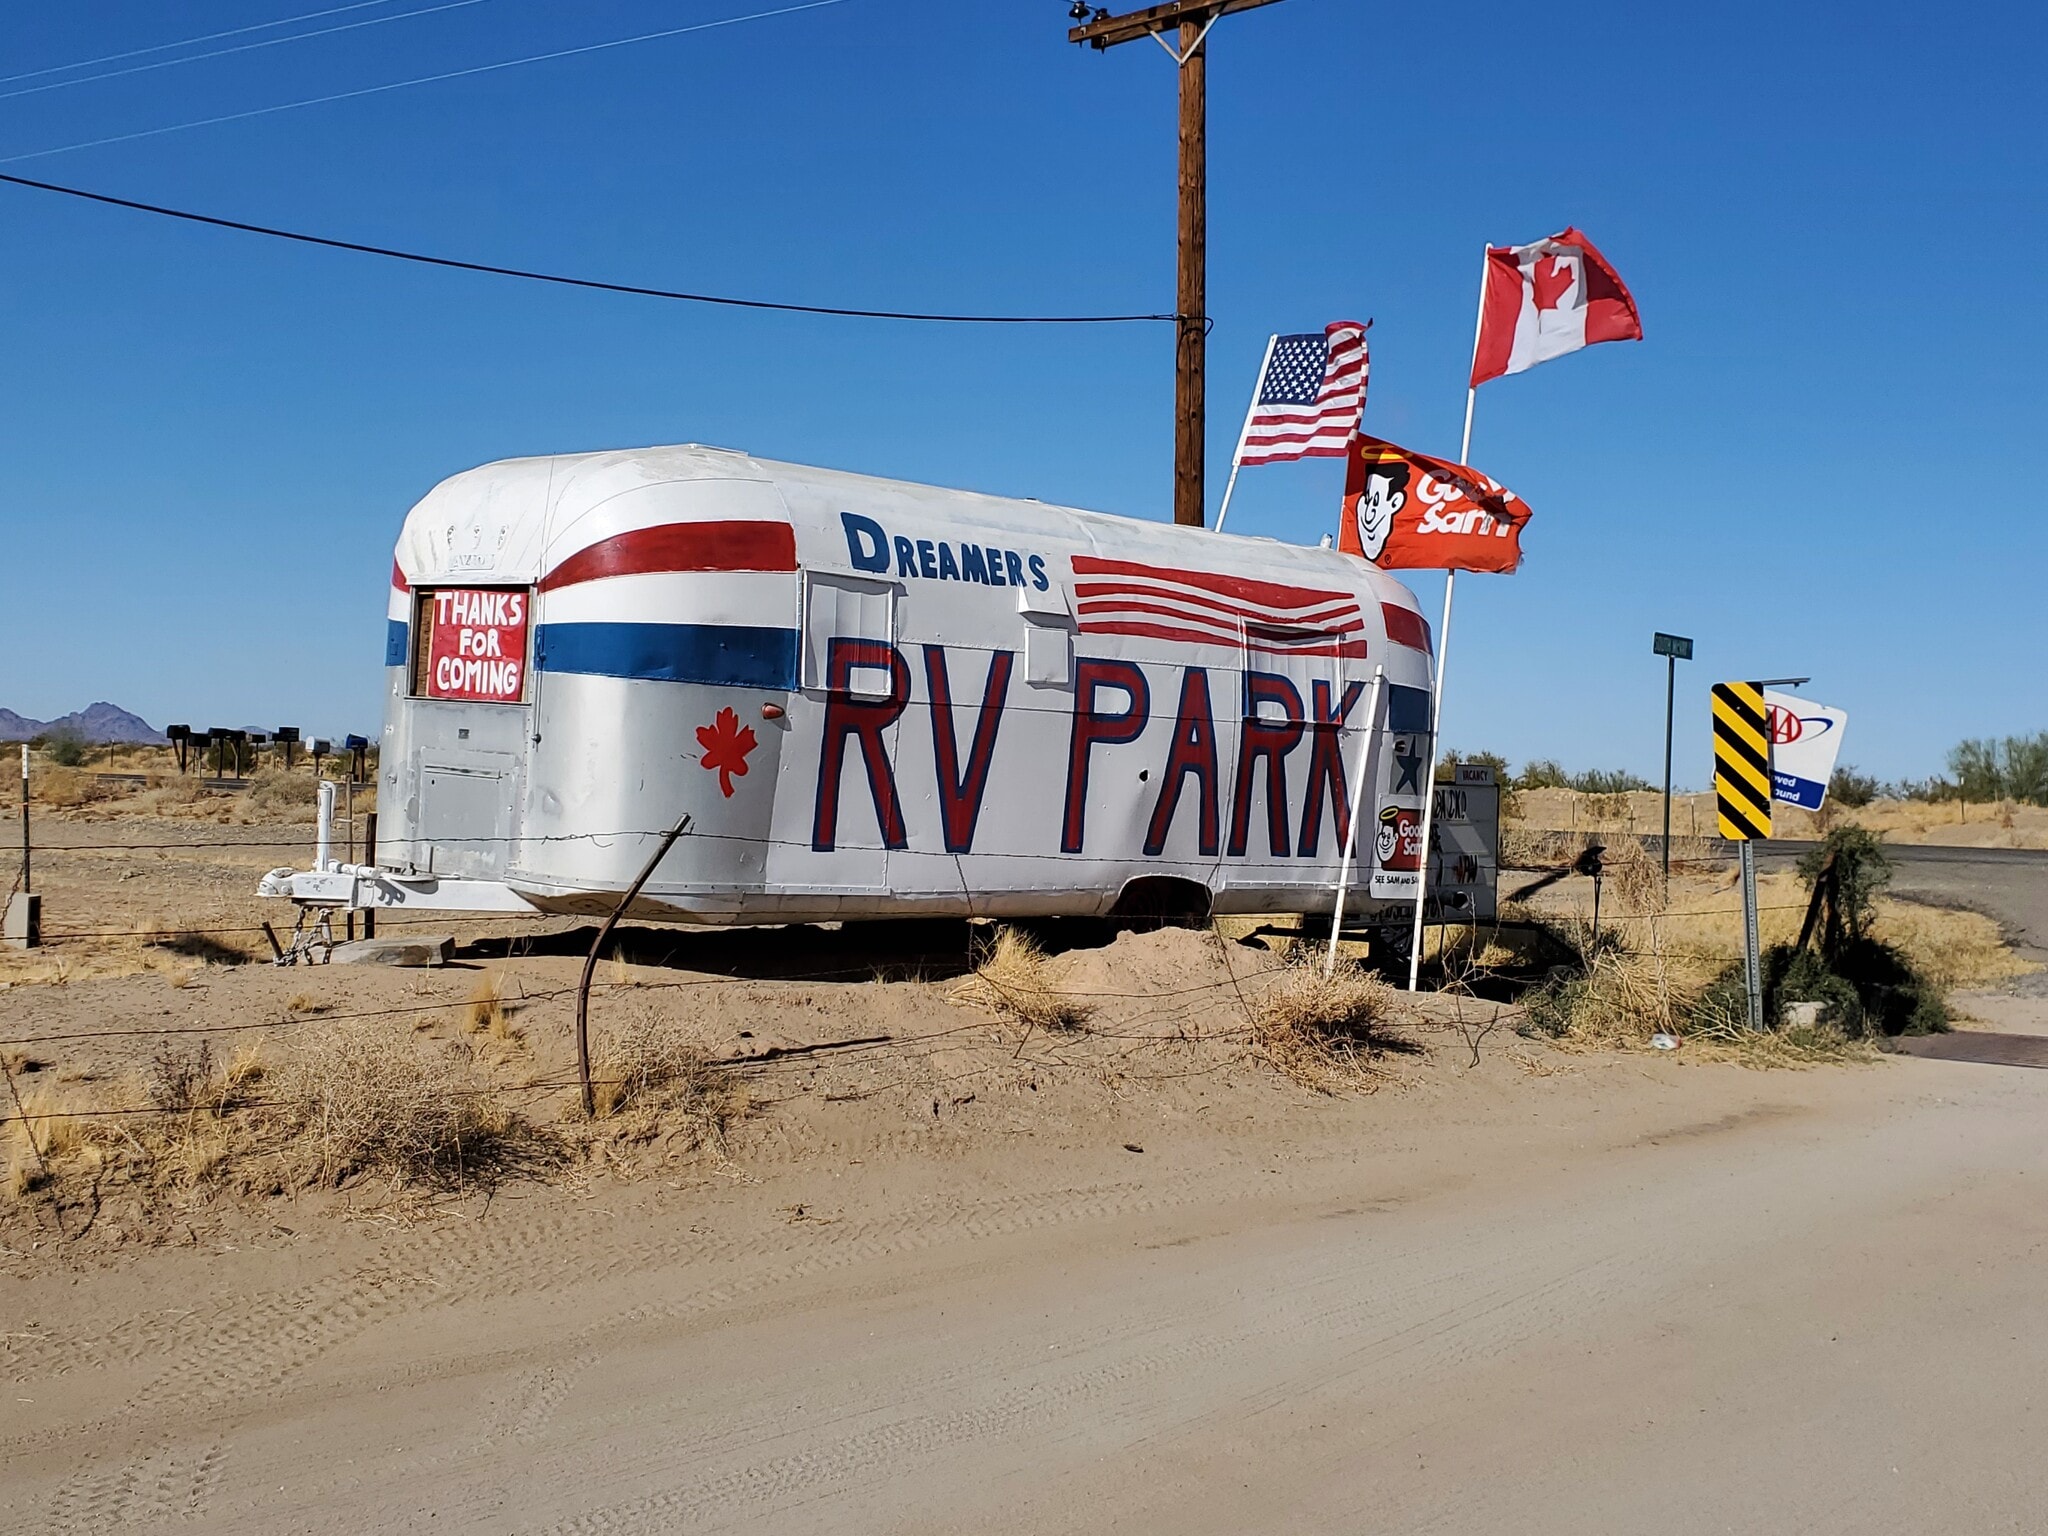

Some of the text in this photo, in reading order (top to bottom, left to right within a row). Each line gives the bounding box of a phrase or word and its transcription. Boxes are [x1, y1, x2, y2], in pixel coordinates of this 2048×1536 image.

[1417, 502, 1510, 537] Sam
[435, 592, 522, 625] THANKS
[459, 628, 501, 657] FOR
[437, 656, 517, 694] COMING
[811, 637, 1367, 858] RV PARK
[1463, 770, 1488, 781] VACANCY
[1375, 875, 1385, 884] SEE
[1387, 875, 1400, 885] SAM
